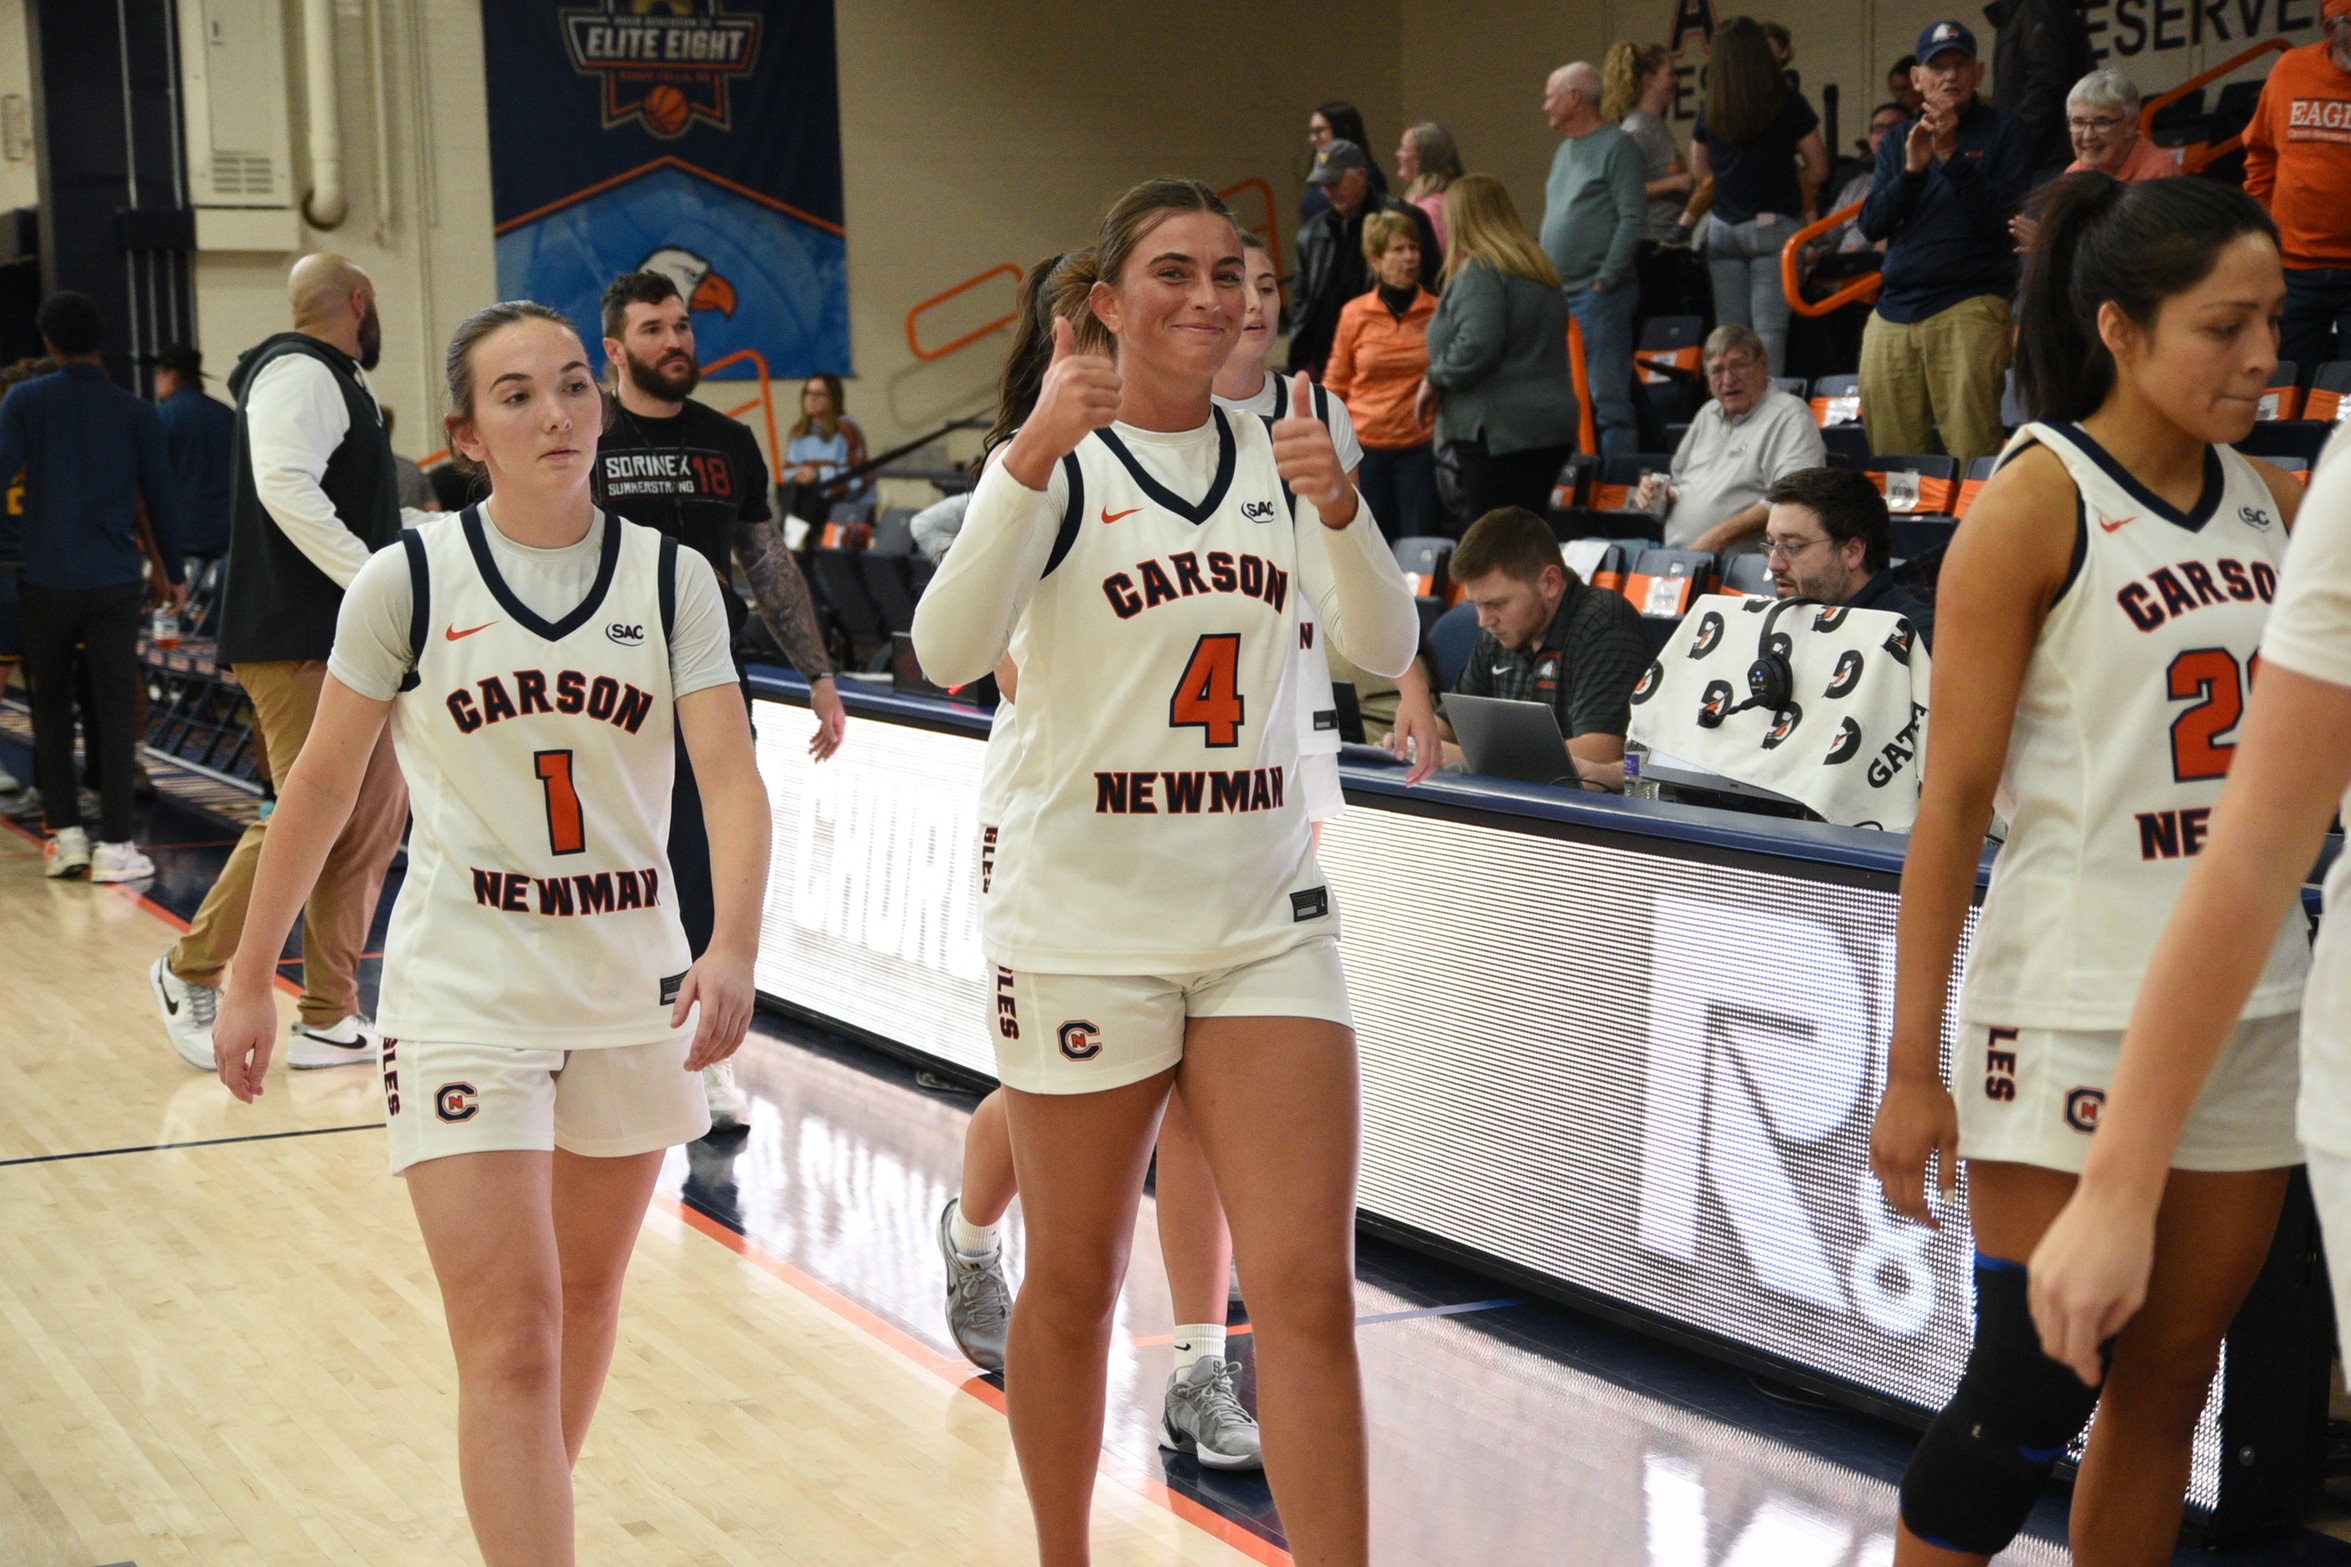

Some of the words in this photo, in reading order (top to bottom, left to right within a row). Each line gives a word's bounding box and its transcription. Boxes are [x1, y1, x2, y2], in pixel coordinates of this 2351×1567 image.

[586, 27, 660, 58] ELITE
[664, 29, 745, 61] EIGHT
[605, 454, 691, 479] SORINEX
[692, 455, 732, 496] 18
[1246, 501, 1274, 517] SAC
[1102, 551, 1288, 620] CARSON
[2117, 557, 2282, 633] CARSO
[611, 623, 645, 640] SAC
[445, 669, 654, 735] CARSON
[1169, 632, 1244, 749] 4
[2166, 646, 2261, 784] 2
[533, 749, 586, 856] 1
[1094, 765, 1284, 815] NEWMAN
[470, 866, 661, 917] NEWMAN
[997, 965, 1020, 1040] LES
